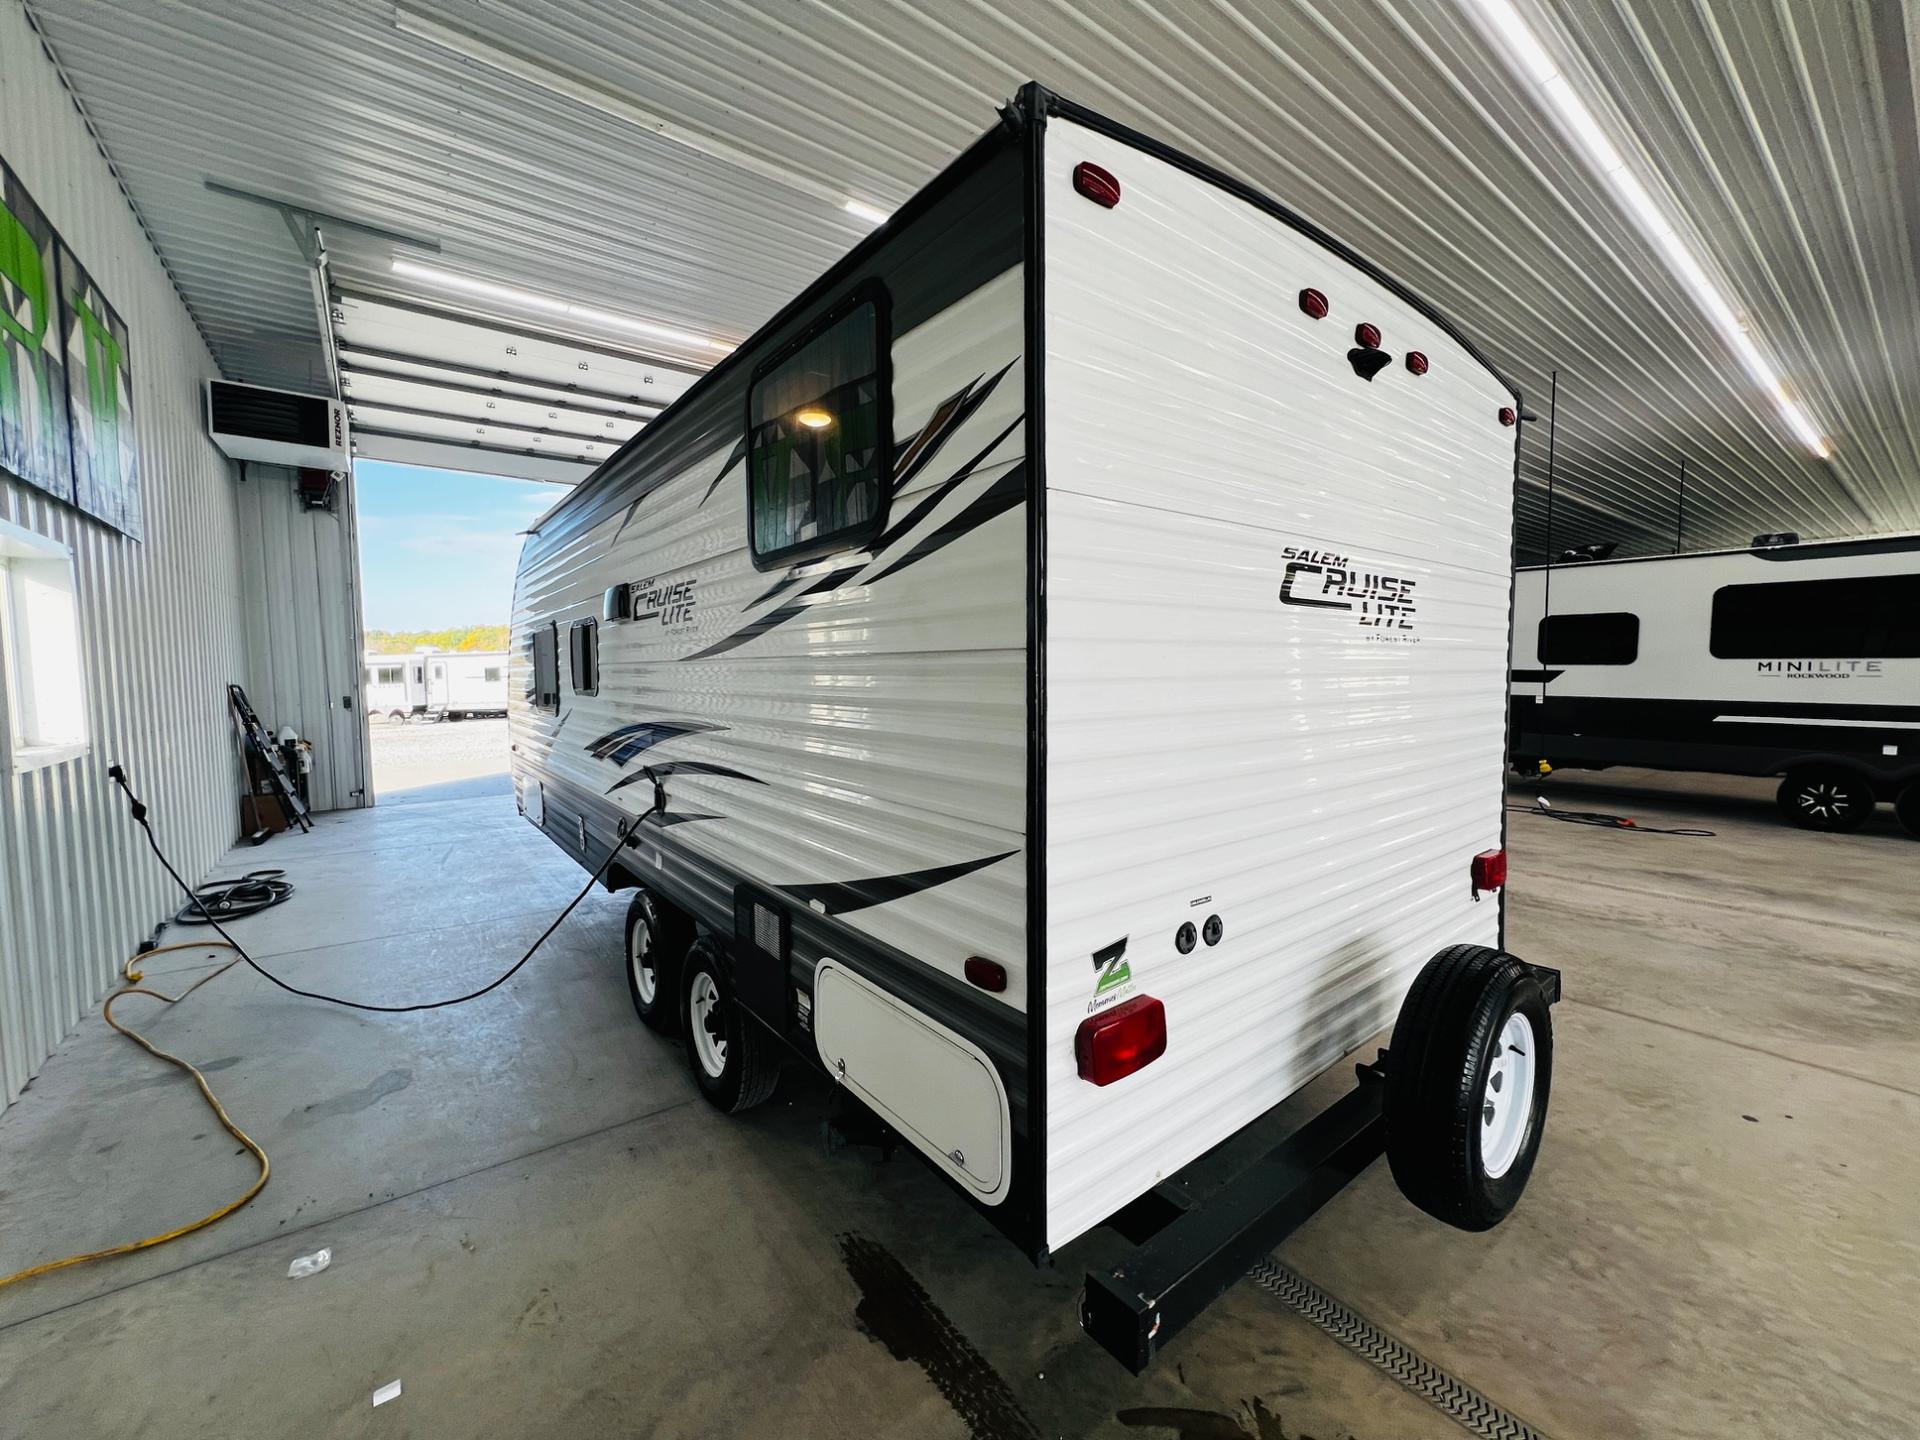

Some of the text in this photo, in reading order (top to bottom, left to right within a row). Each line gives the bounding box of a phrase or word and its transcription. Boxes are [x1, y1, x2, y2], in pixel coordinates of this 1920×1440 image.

[333, 408, 342, 447] REZNOR
[1280, 547, 1349, 568] SALEM
[633, 579, 697, 621] CRUISE
[1279, 561, 1416, 611] CRUISE
[661, 601, 696, 626] LITE
[1359, 601, 1416, 630] LITE
[1758, 660, 1883, 672] MINILITE
